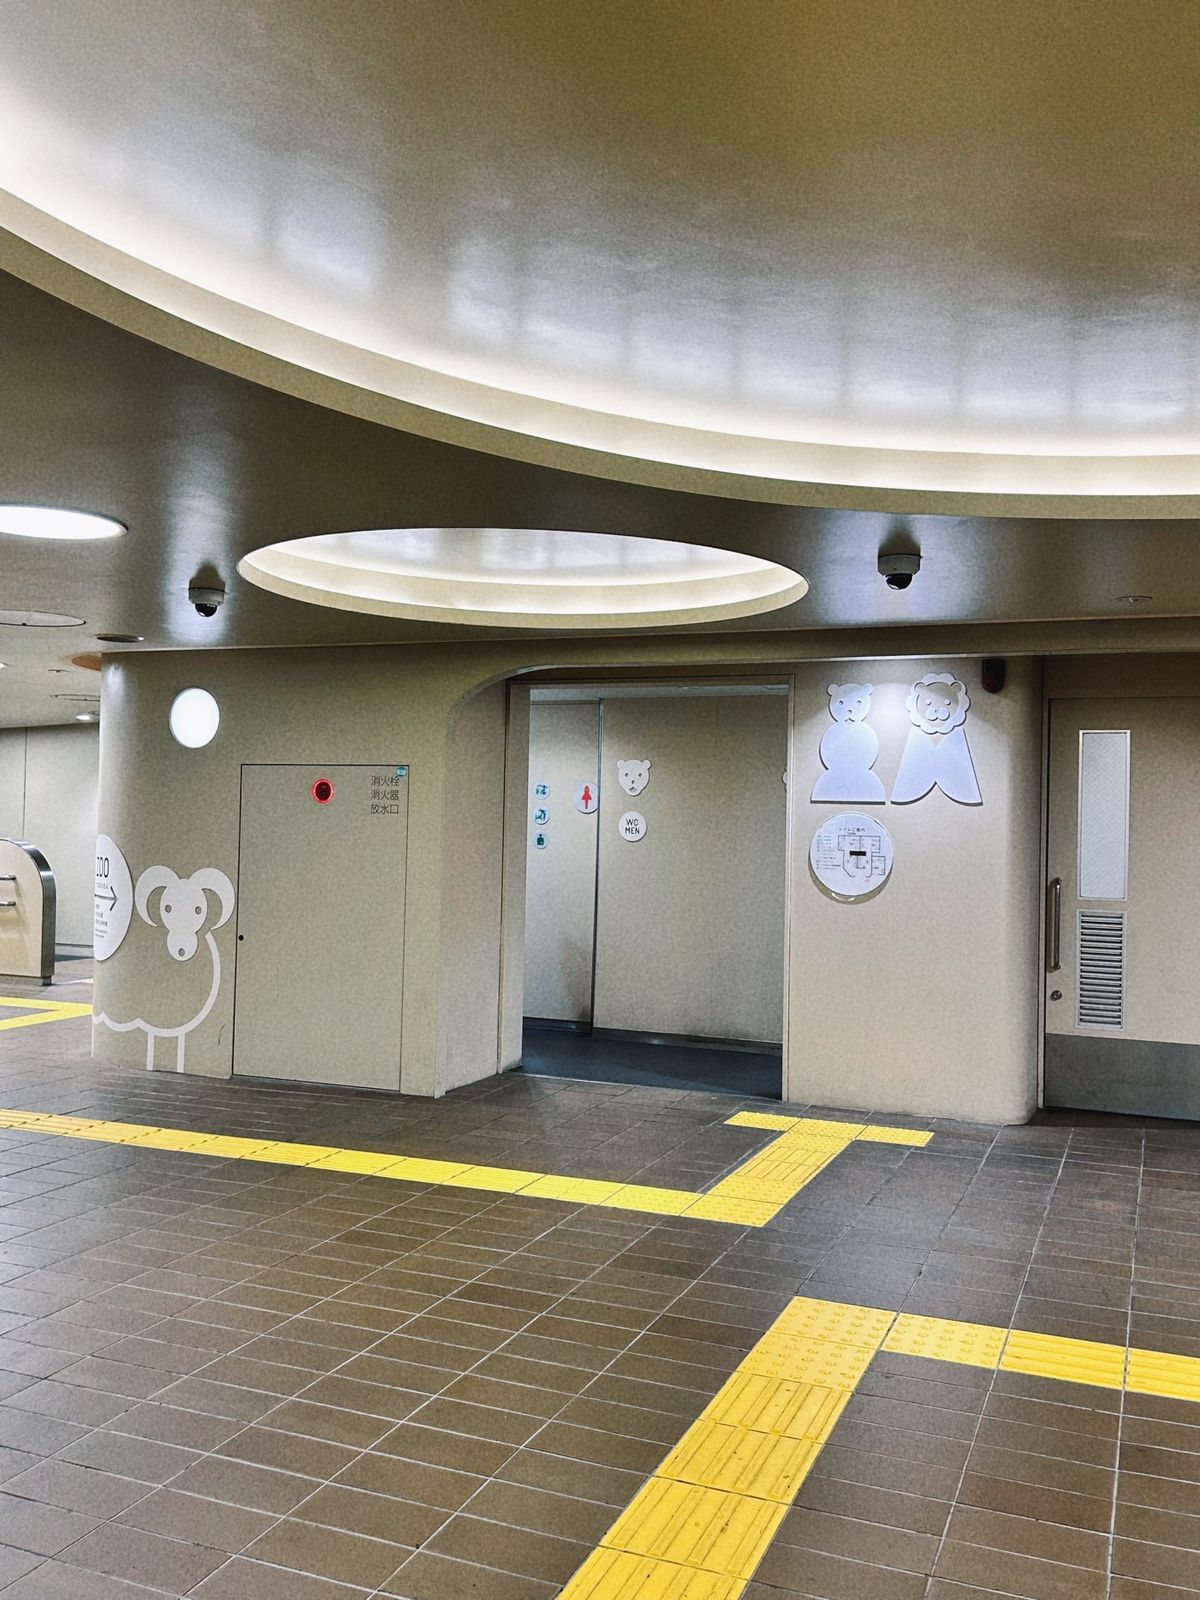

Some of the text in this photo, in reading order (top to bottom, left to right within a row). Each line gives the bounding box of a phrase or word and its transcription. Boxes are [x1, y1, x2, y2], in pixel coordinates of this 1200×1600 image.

[371, 775, 400, 787] 消火栓
[370, 789, 400, 801] 消火器
[370, 804, 399, 815] 放水口
[626, 818, 639, 827] WO
[624, 826, 640, 835] MEN
